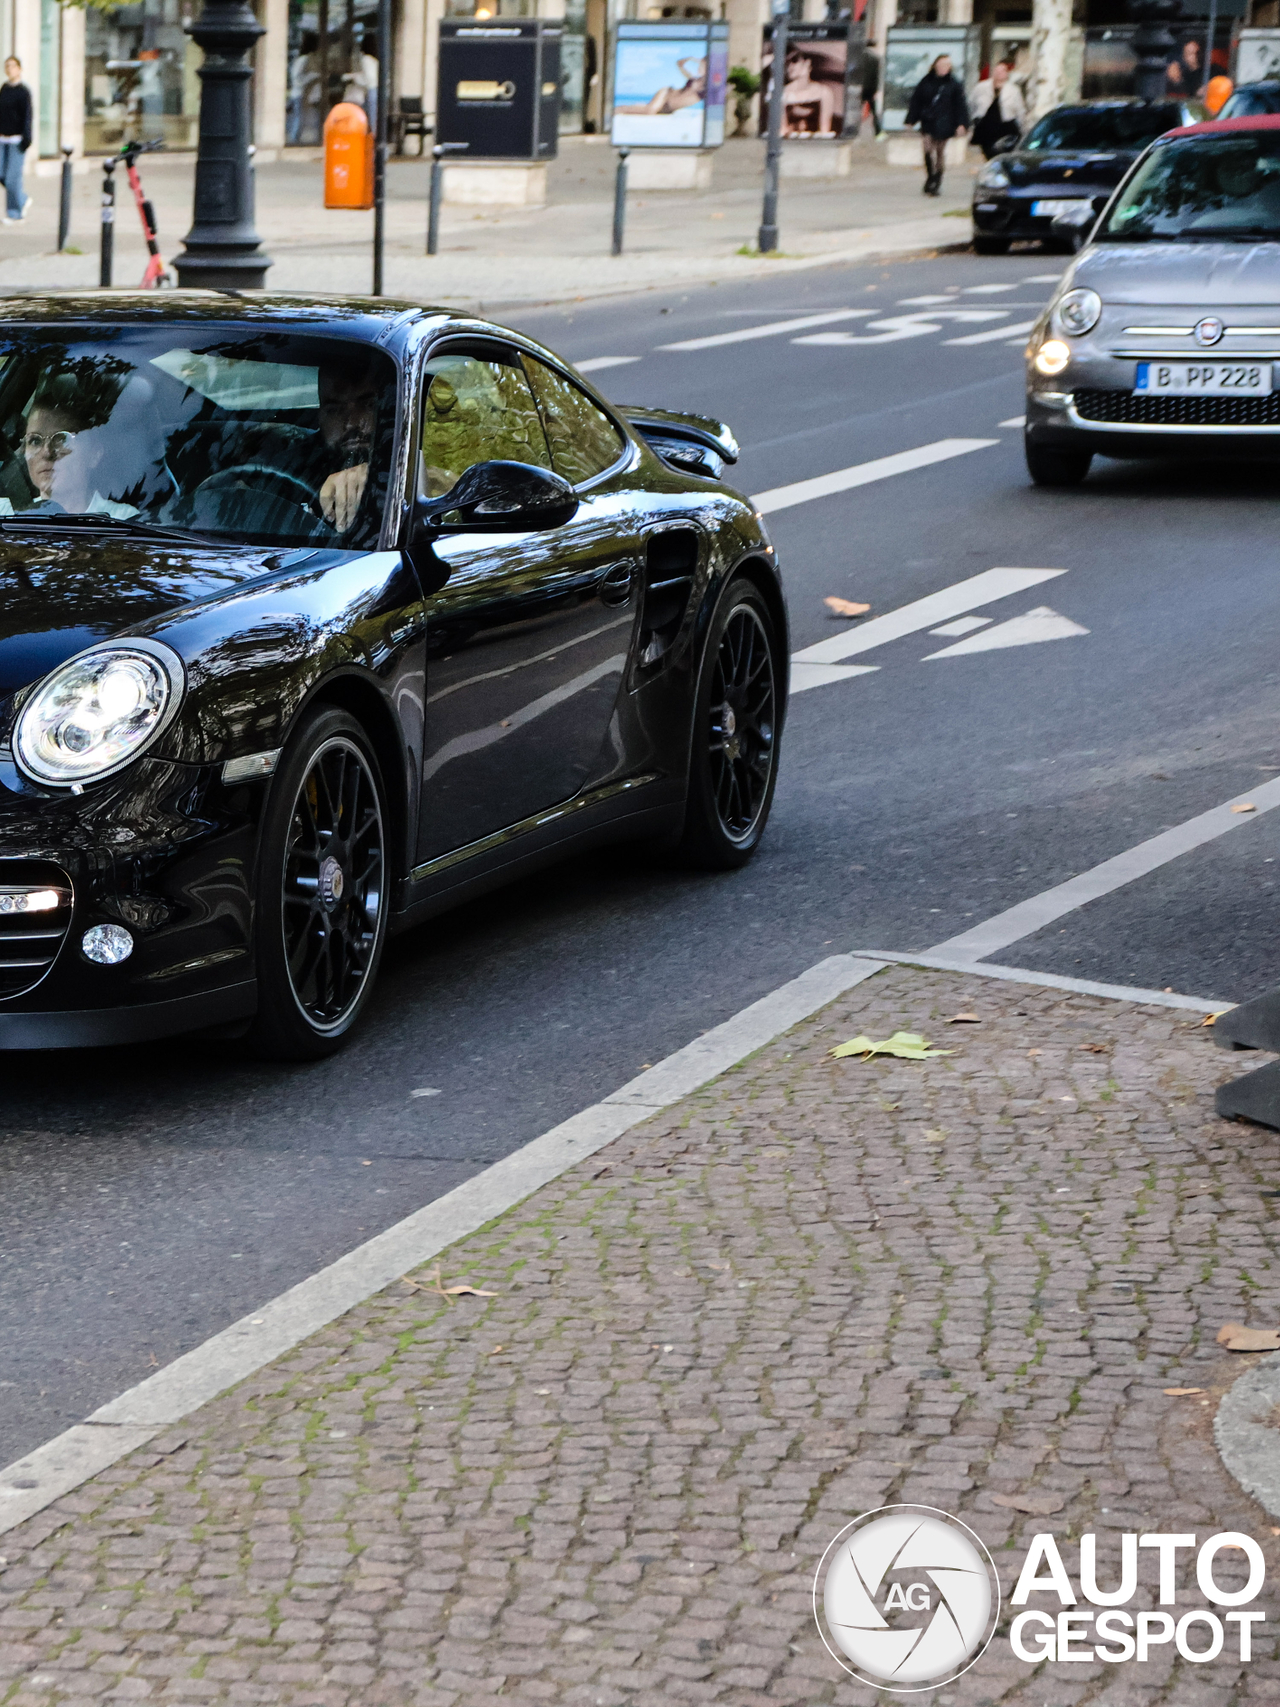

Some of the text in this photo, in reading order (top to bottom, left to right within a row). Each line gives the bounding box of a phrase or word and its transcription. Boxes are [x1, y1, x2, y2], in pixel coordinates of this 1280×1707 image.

[1157, 367, 1172, 387] B
[1186, 367, 1214, 387] PP
[1219, 367, 1261, 387] 228
